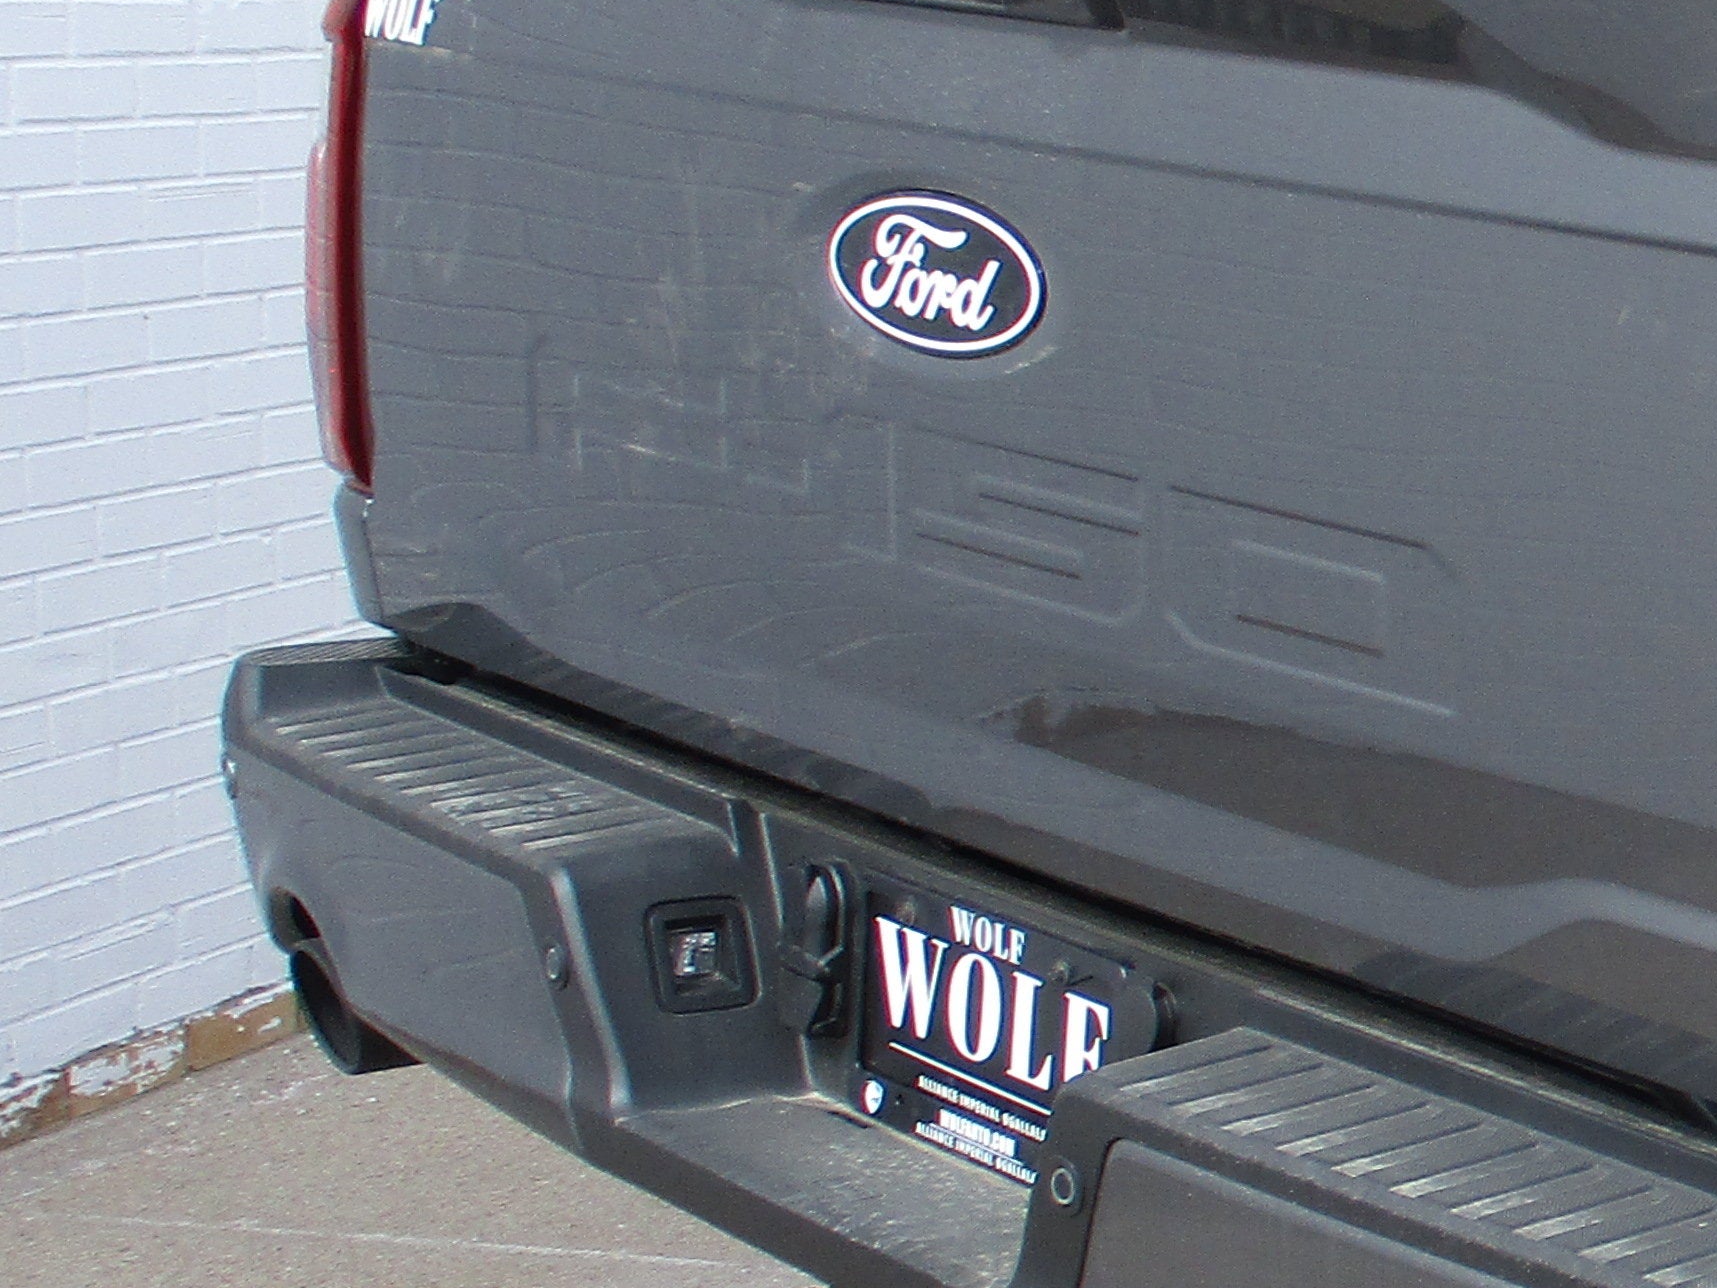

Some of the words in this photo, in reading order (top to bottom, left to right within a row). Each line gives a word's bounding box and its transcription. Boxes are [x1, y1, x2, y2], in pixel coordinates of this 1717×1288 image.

[860, 213, 1001, 331] Ford
[950, 905, 1026, 965] WOLF
[874, 915, 1110, 1092] WOLF
